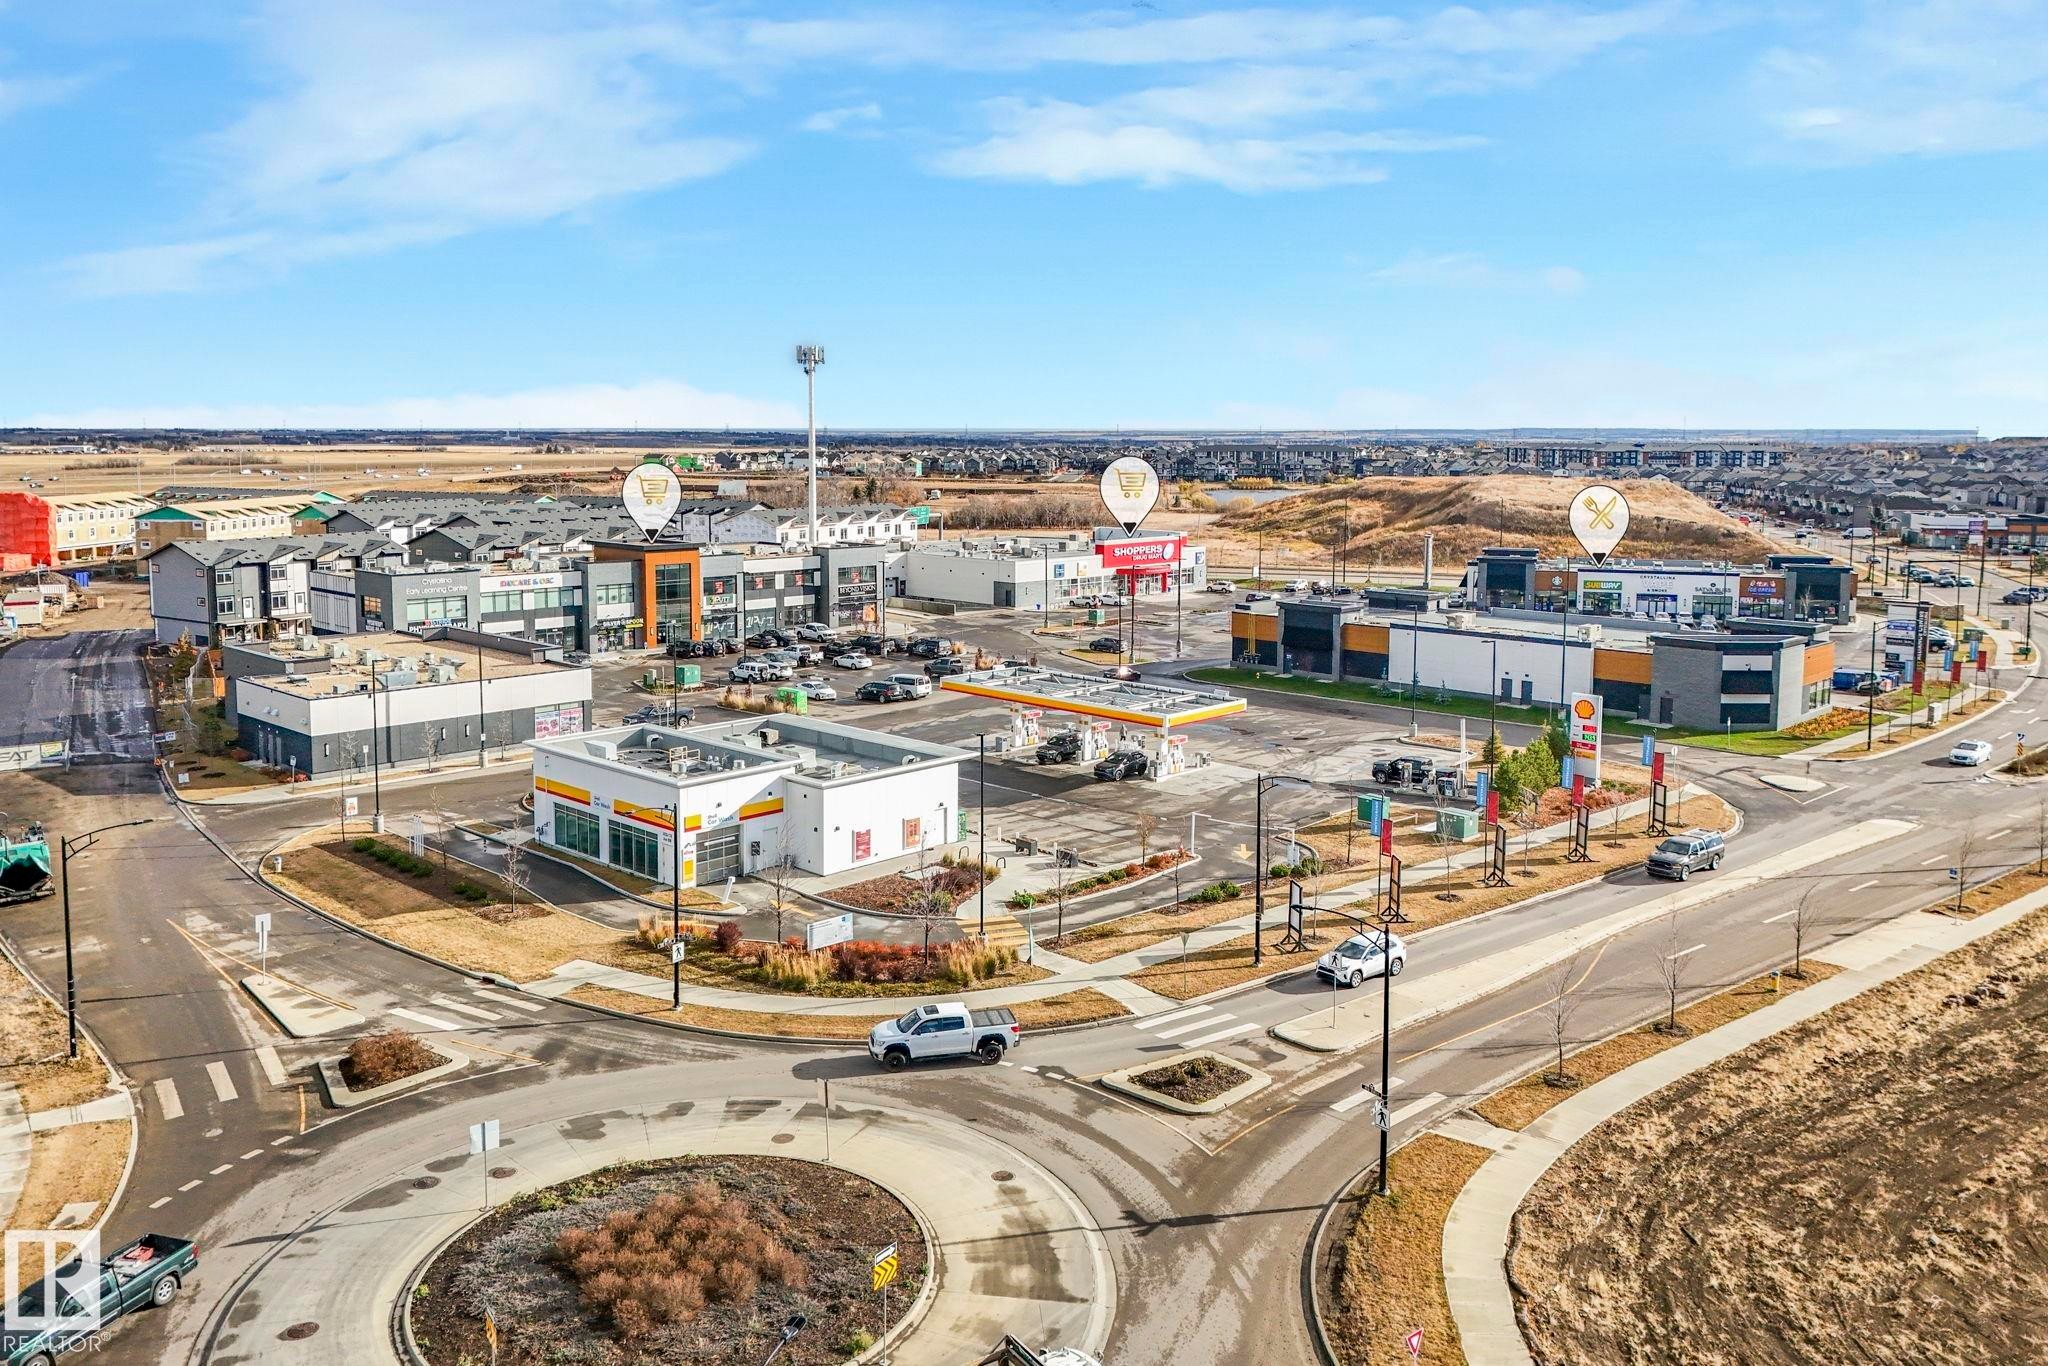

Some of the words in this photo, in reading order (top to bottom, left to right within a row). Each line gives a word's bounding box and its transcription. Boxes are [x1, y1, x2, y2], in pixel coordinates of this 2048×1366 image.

[1114, 545, 1163, 556] SHOPPERS
[500, 578, 532, 587] DAYCARE
[1585, 581, 1621, 589] SUBWAY
[406, 588, 420, 596] Early
[421, 586, 447, 594] Learning
[840, 586, 859, 594] BEYOND
[859, 584, 876, 592] VISION
[719, 815, 734, 823] Wash
